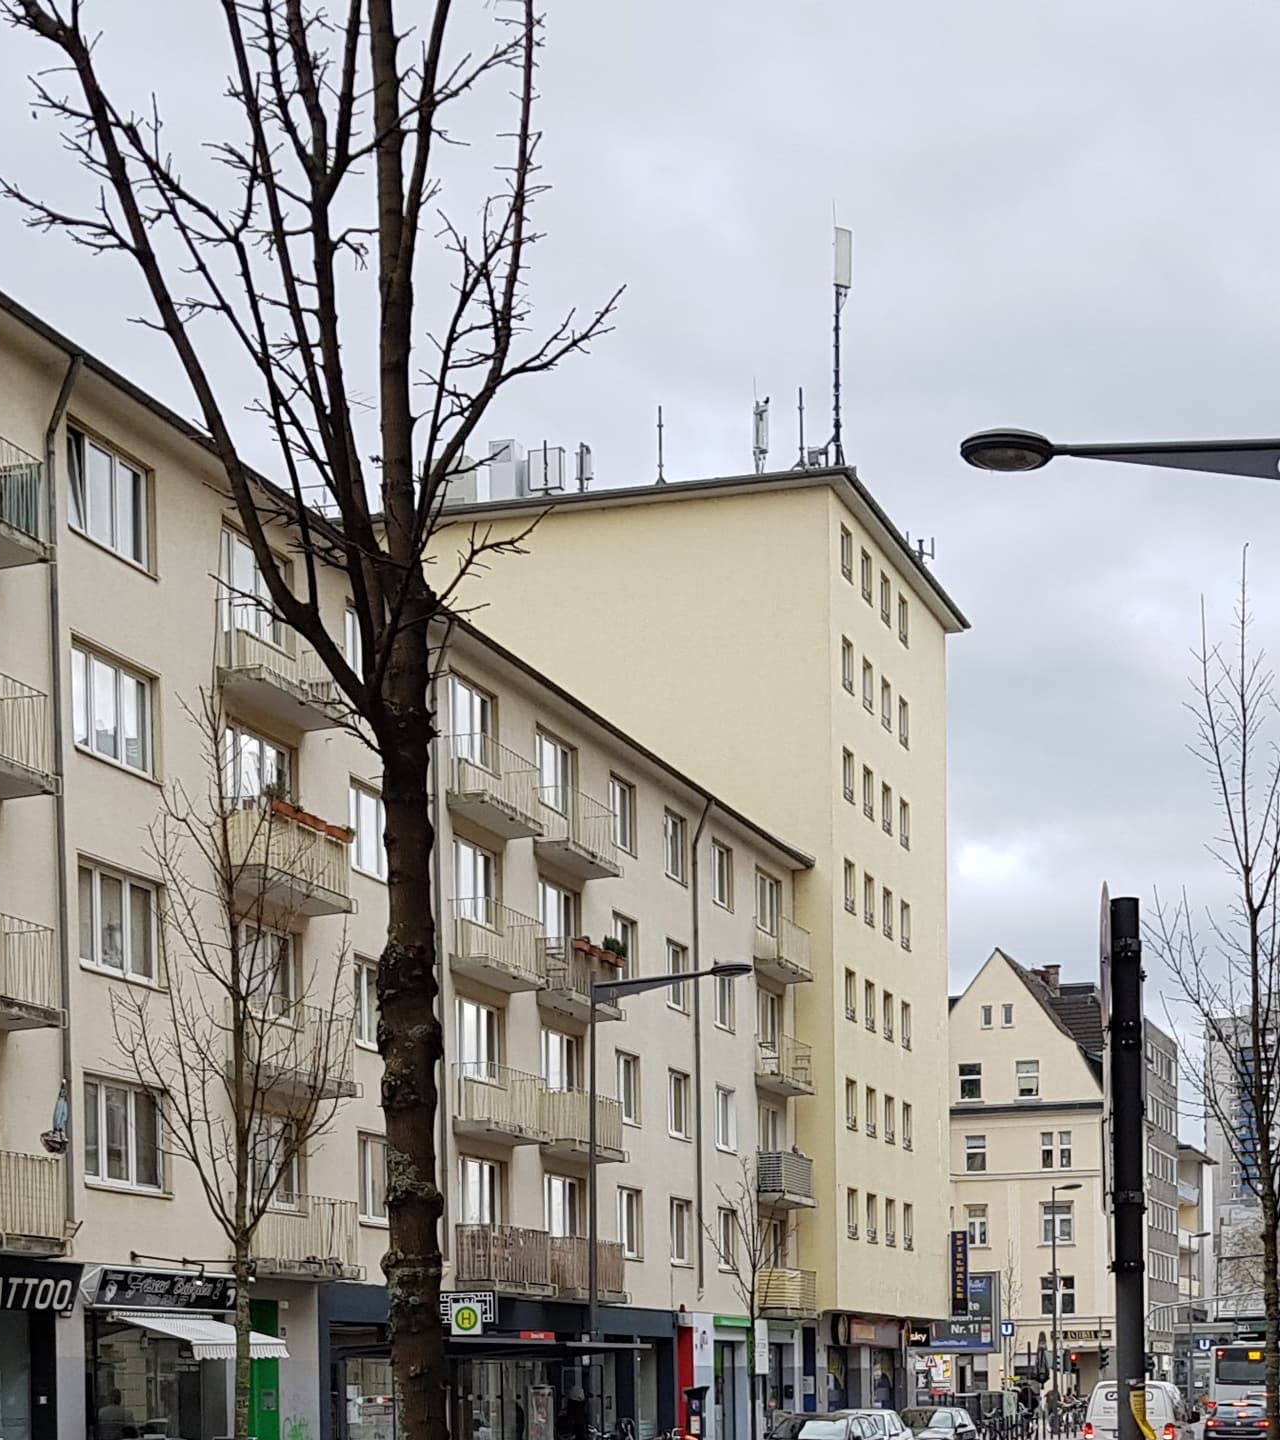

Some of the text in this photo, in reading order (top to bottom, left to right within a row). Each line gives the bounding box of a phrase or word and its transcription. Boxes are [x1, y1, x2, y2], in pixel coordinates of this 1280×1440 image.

[461, 1311, 472, 1326] H
[950, 1324, 967, 1334] Nr.
[1001, 1324, 1012, 1335] U
[910, 1331, 927, 1343] sky
[1199, 1339, 1210, 1350] U
